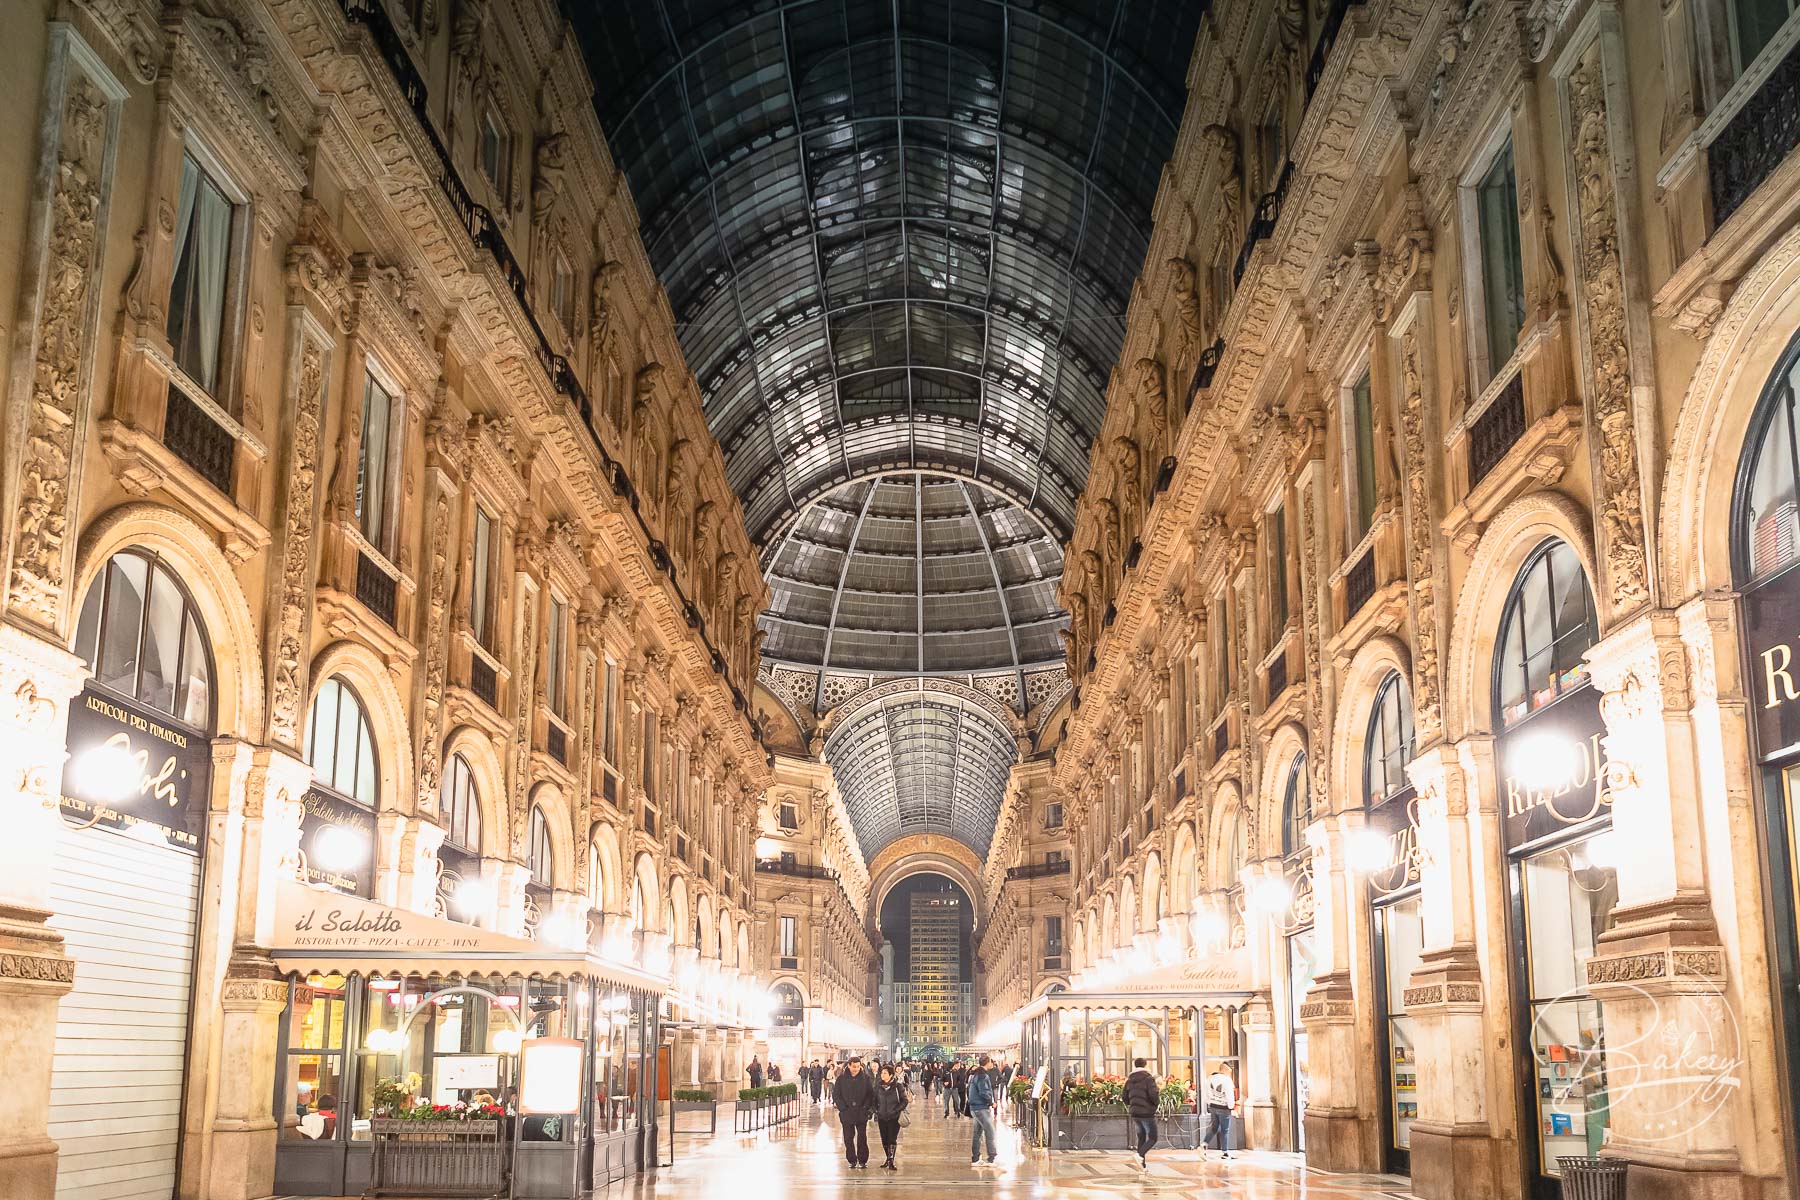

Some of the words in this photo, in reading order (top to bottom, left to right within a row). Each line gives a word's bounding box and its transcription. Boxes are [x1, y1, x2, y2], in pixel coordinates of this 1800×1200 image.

[86, 695, 127, 723] ARTICOLI
[130, 715, 147, 732] PER
[149, 722, 187, 749] FUMATORI
[295, 910, 315, 931] il
[321, 910, 402, 932] Salotto
[295, 937, 361, 946] RISTORANTE
[368, 938, 399, 946] PIZZA
[453, 938, 481, 947] WINE
[1180, 964, 1239, 981] Galleria
